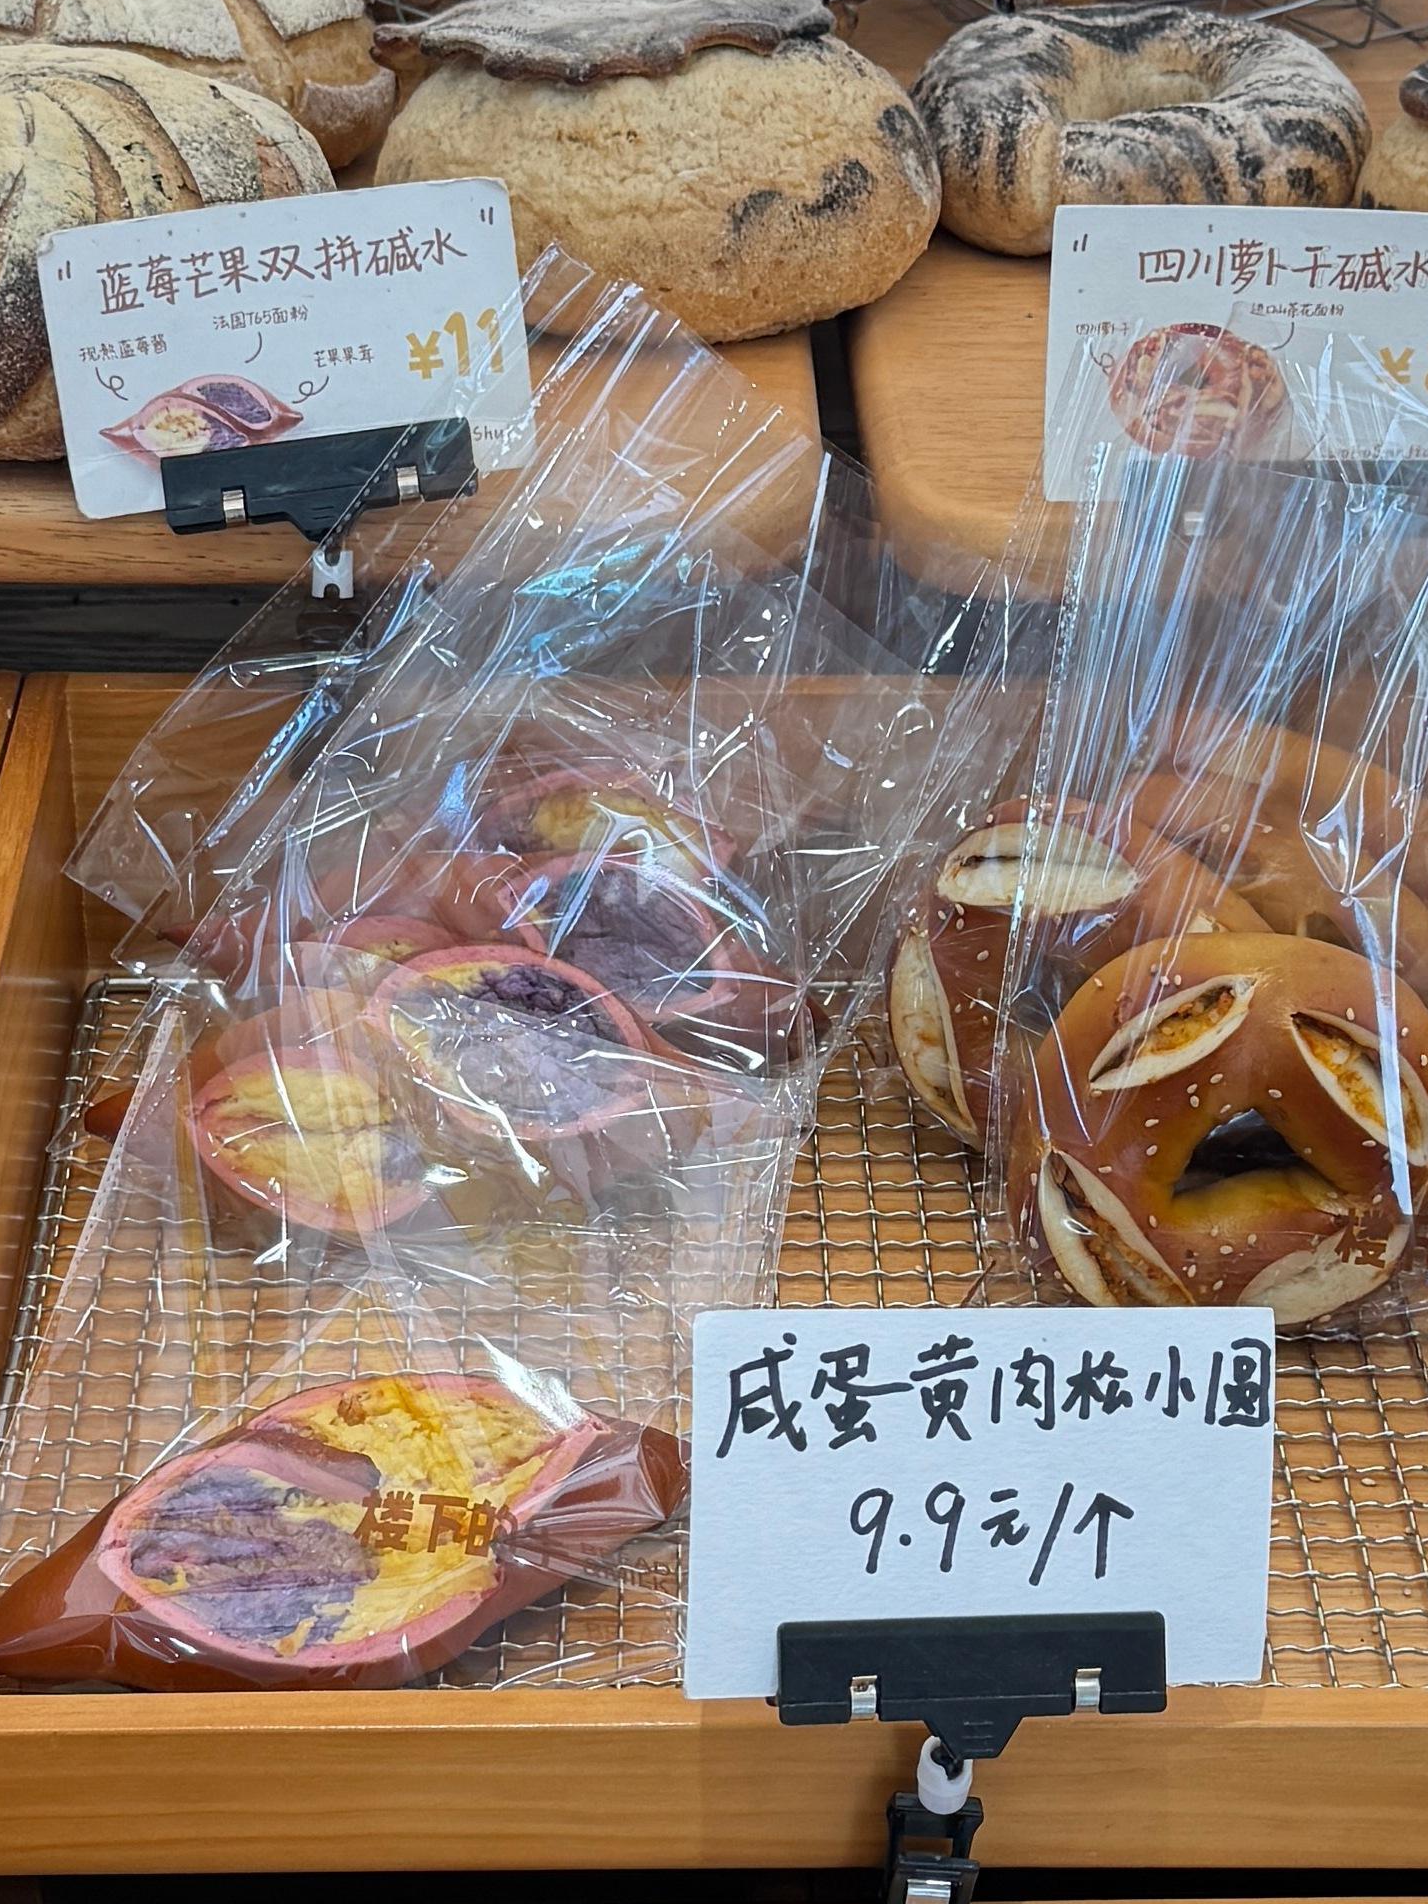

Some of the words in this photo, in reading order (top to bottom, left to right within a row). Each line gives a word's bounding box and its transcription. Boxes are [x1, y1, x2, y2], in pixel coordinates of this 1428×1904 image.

[97, 226, 467, 315] 蓝莓芒果双拼碱水
[213, 306, 309, 330] 法国T65面粉
[406, 307, 504, 380] ¥11
[849, 1480, 1135, 1587] 9.9元/个
